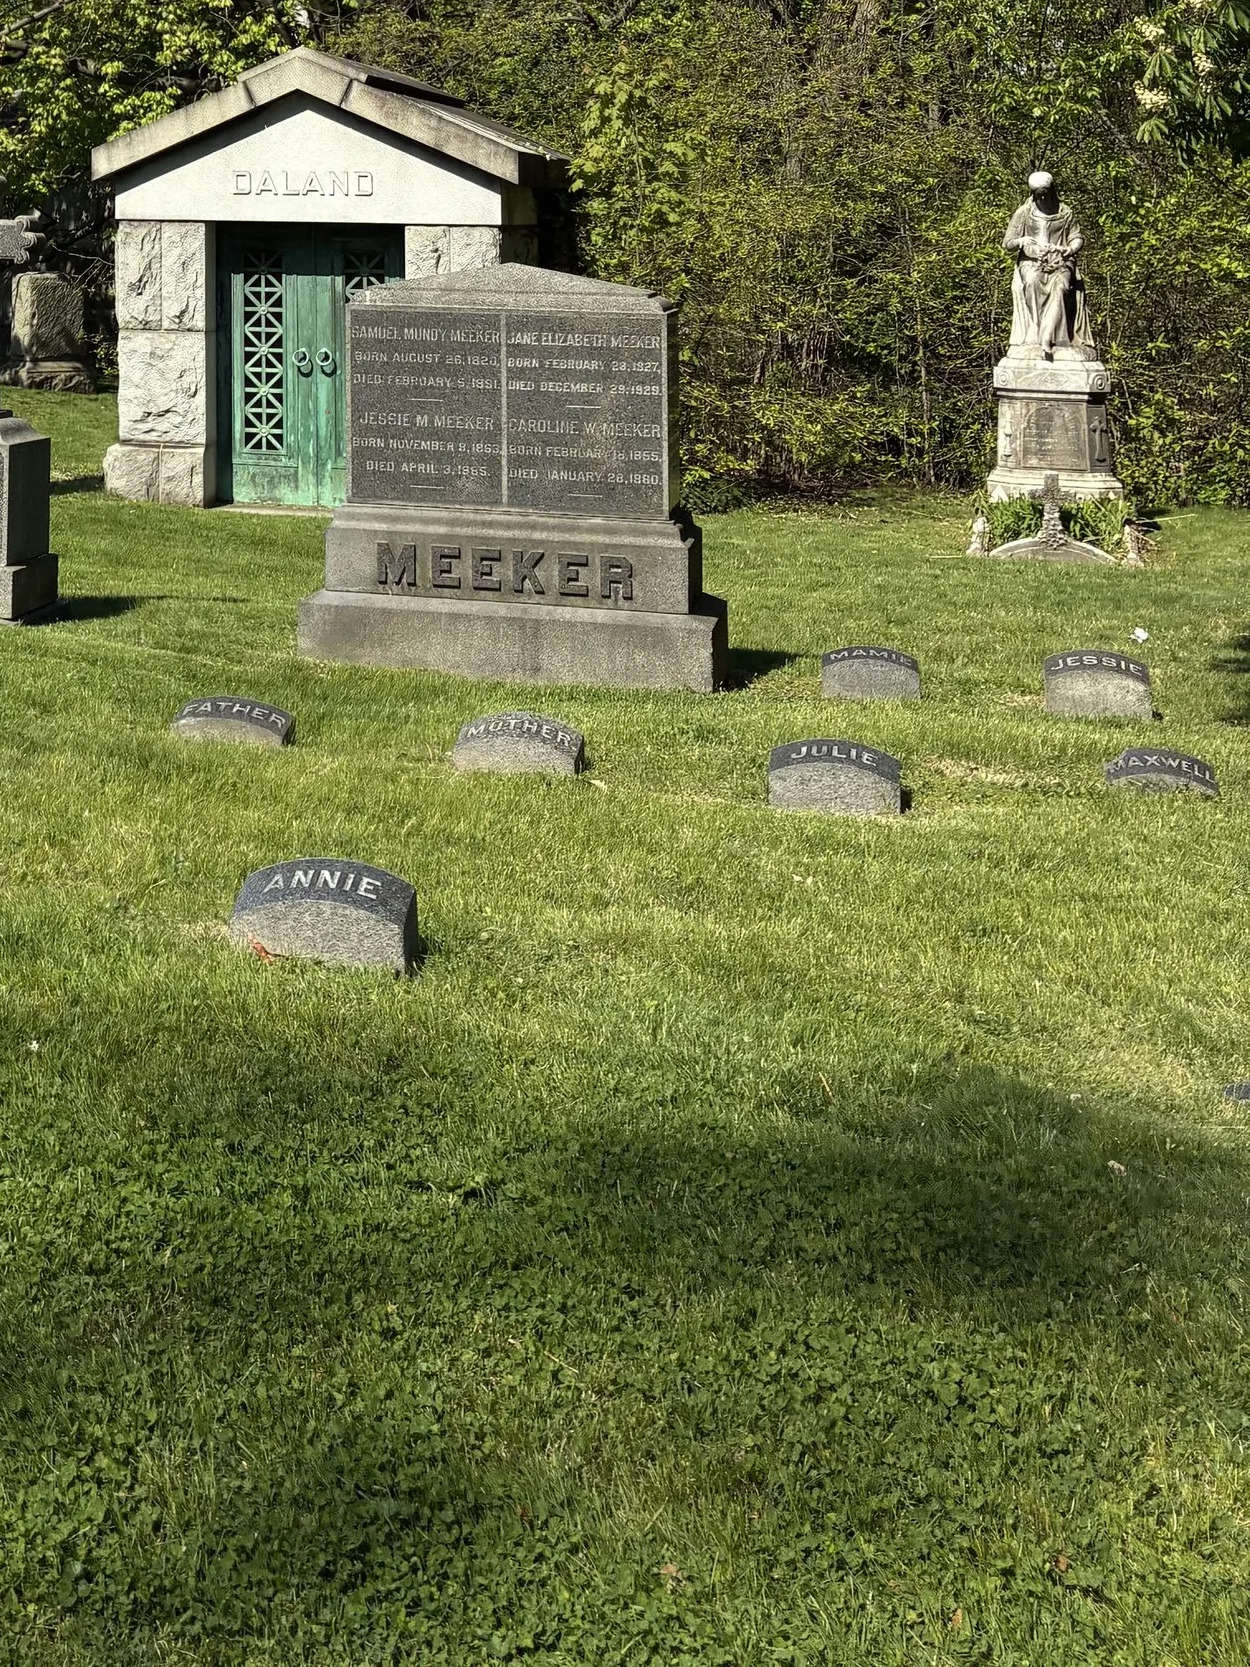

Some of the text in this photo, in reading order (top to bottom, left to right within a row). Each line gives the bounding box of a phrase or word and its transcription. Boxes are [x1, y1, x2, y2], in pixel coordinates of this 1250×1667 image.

[231, 170, 374, 197] DALAND
[351, 325, 500, 343] SAMUEL MUNDY MEEKER
[507, 332, 661, 349] JANE ELIZABETH MEEKER
[355, 351, 387, 362] BORN
[392, 352, 441, 363] AUGUST
[508, 357, 539, 368] BORN
[545, 359, 606, 370] FEBRUARY
[354, 374, 381, 384] DIED
[388, 375, 451, 387] FEBRUARY
[508, 380, 535, 391] DIED
[540, 382, 603, 393] DECEMBER
[360, 411, 494, 430] JESSIE M. MEEKER
[508, 418, 579, 434] CAROLINE
[601, 422, 661, 438] MEEKER
[352, 437, 384, 447] BORN
[389, 438, 454, 451] NOVEMBER
[509, 444, 542, 456] BORN
[546, 446, 609, 459] FEBRUARY
[366, 460, 395, 472] DIED
[401, 462, 439, 474] APRIL
[510, 468, 538, 479] DIED
[546, 469, 604, 482] JANUARY
[376, 540, 633, 600] MEEKER
[829, 649, 912, 666] MAMIE
[1050, 655, 1143, 676] JESSIE
[182, 701, 286, 729] FATHER
[466, 718, 571, 747] MOTHER
[790, 745, 878, 767] JULIE
[1108, 755, 1216, 784] MAXWELL
[260, 869, 383, 900] ANNIE
